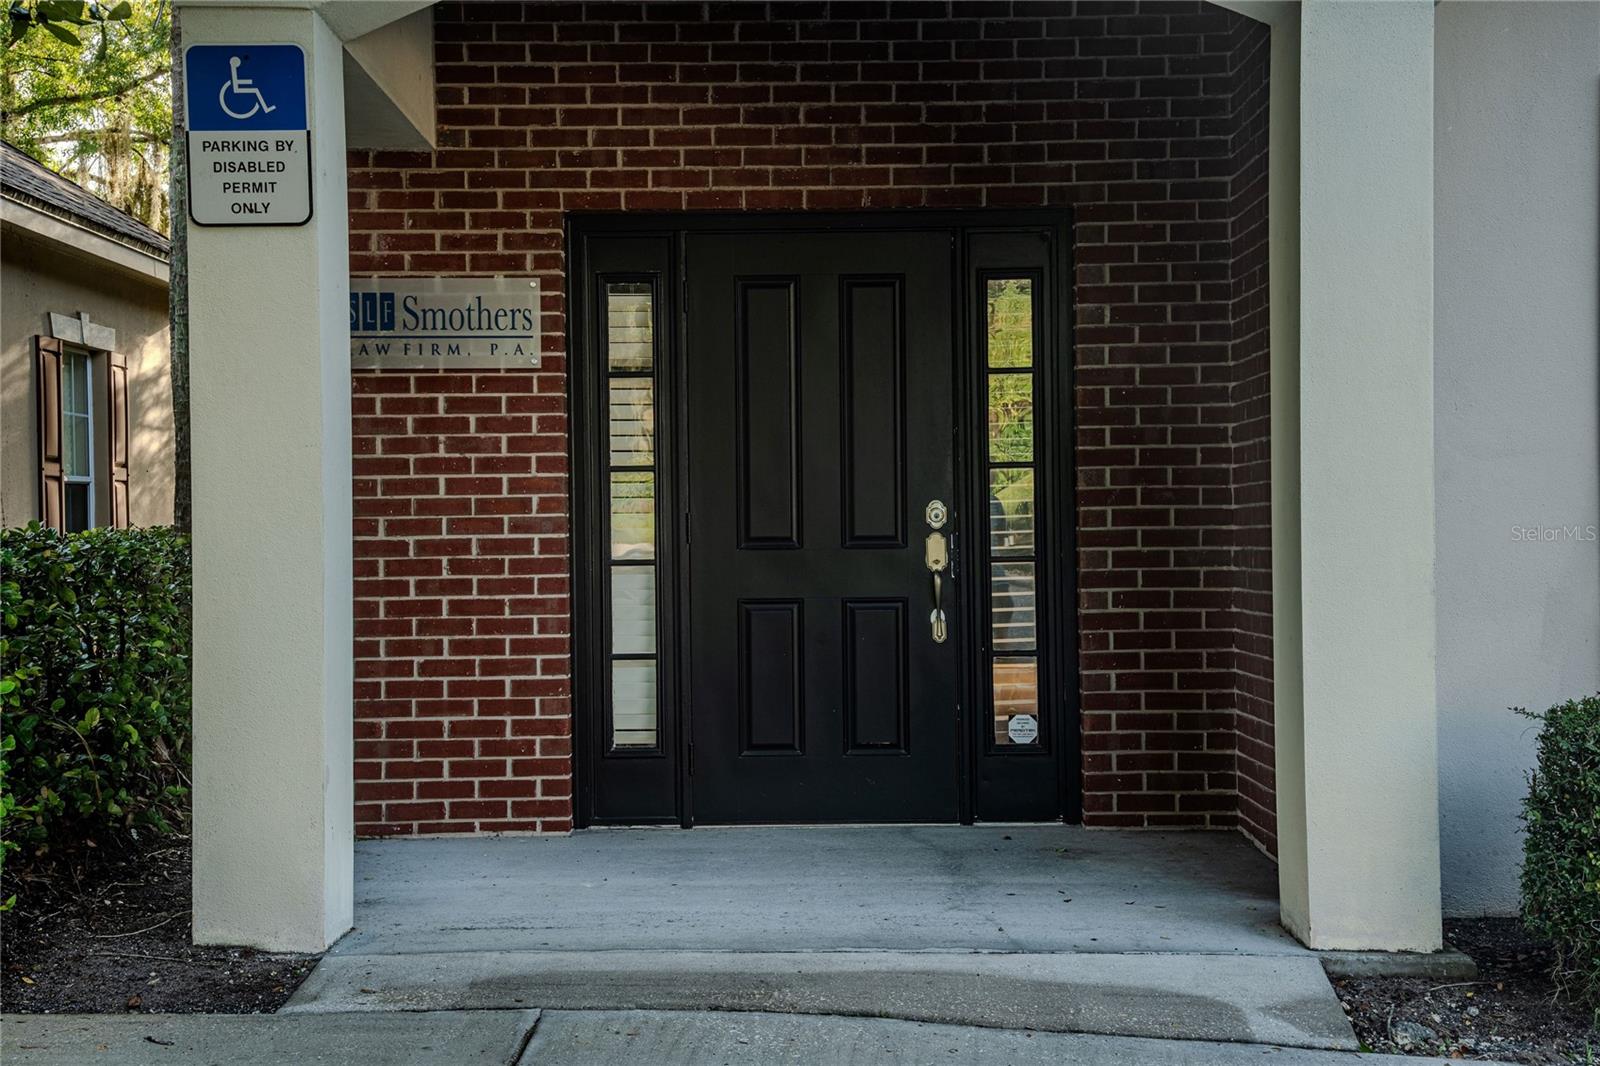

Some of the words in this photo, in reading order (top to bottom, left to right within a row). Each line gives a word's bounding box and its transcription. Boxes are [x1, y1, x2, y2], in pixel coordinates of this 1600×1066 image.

[202, 140, 269, 152] PARKING
[275, 140, 294, 152] BY
[213, 161, 286, 173] DISABLED
[223, 182, 277, 194] PERMIT
[231, 202, 271, 214] ONLY
[402, 295, 533, 331] Smothers
[351, 343, 390, 356] AW
[490, 343, 533, 356] P.A.
